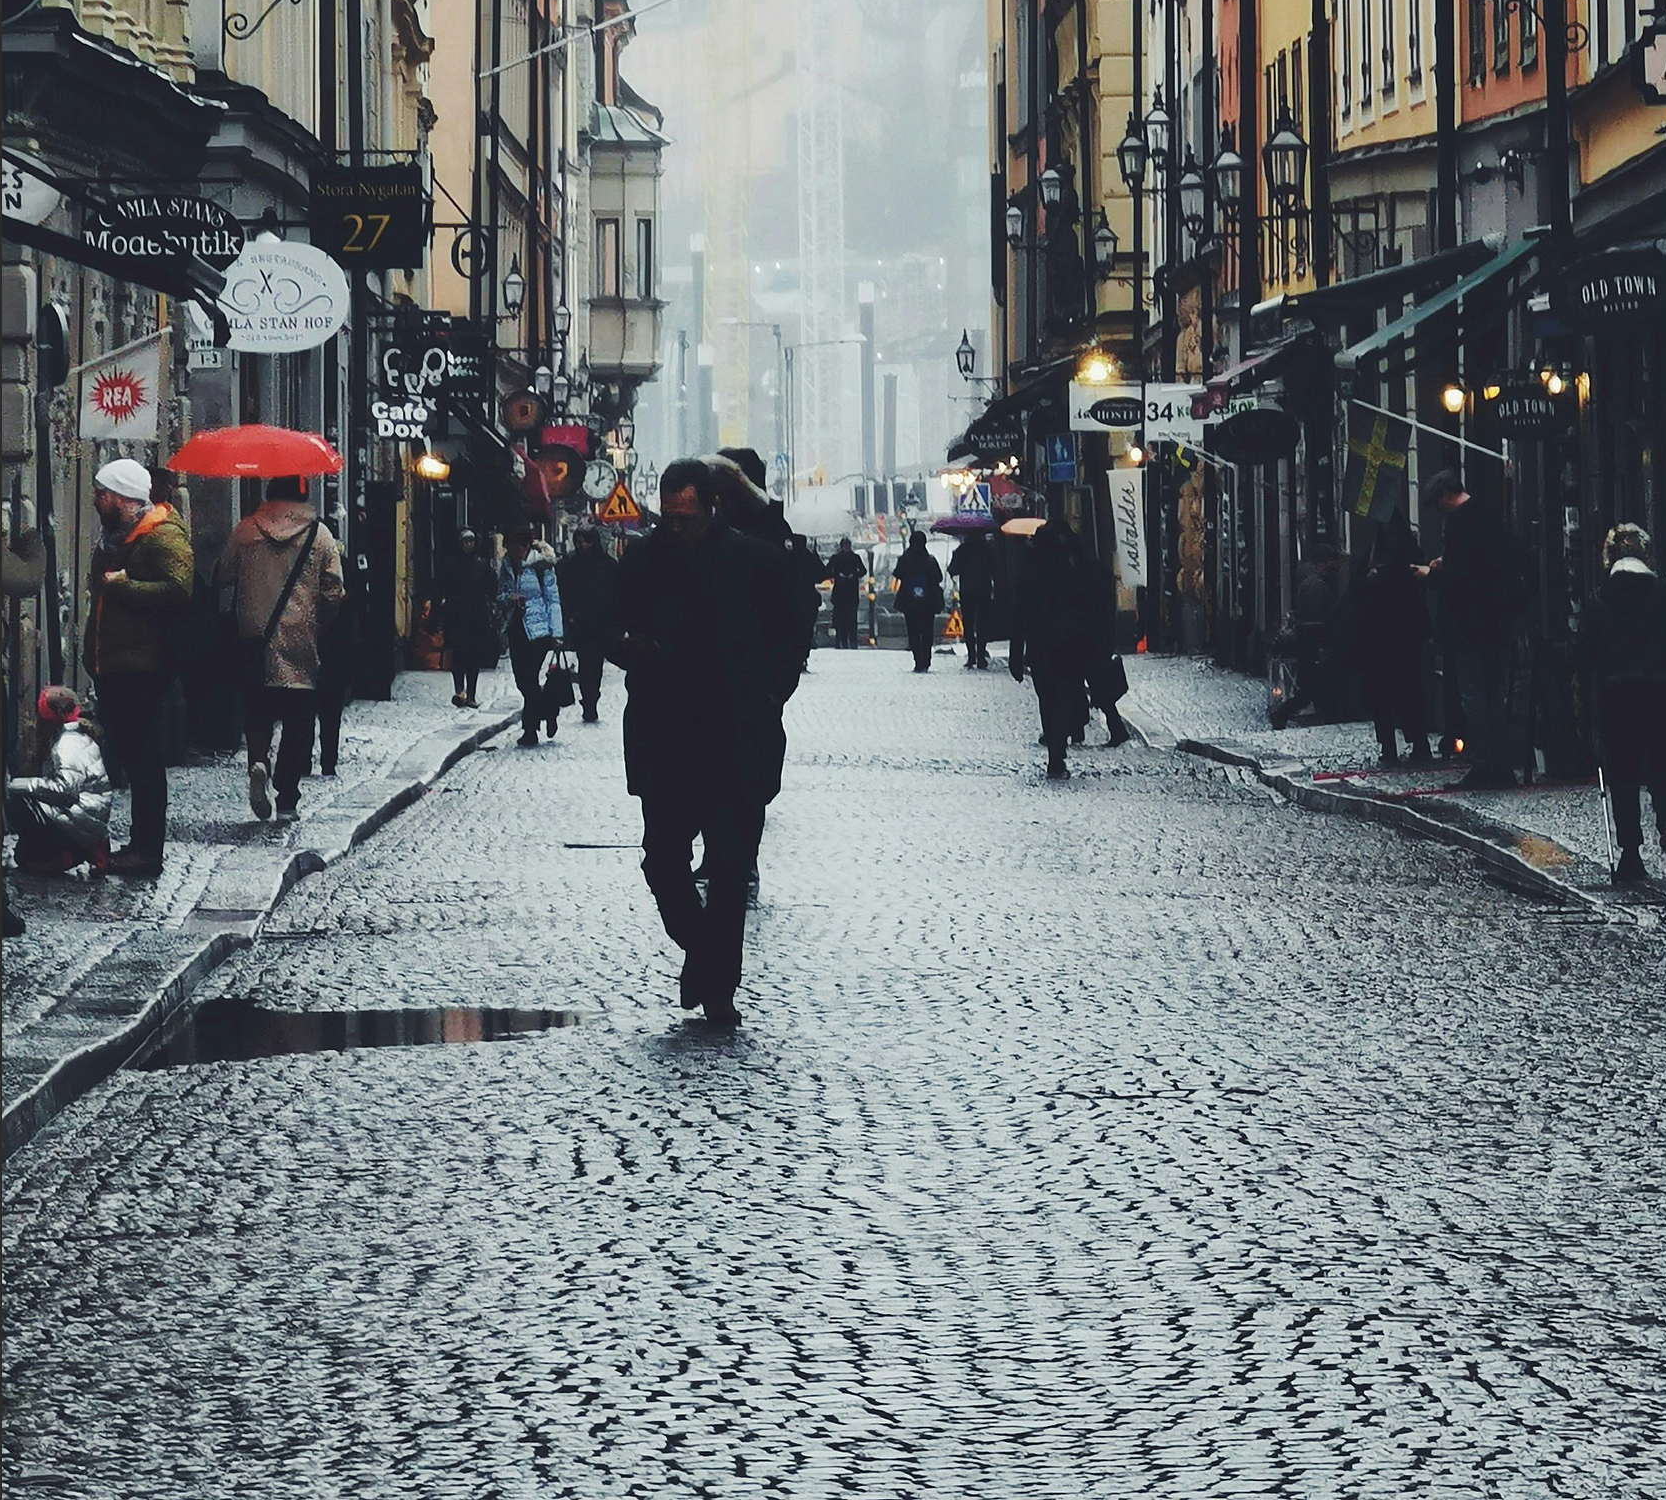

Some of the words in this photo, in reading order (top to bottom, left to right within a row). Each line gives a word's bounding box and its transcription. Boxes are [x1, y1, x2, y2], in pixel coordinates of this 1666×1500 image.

[317, 184, 354, 197] Stora
[359, 182, 416, 200] Nygatan
[166, 197, 226, 228] STANS
[342, 214, 391, 251] 27
[1581, 279, 1608, 304] OLD
[1614, 275, 1656, 296] TOWN
[260, 317, 298, 330] STAN
[102, 386, 132, 408] REA
[1147, 402, 1174, 423] 34
[1498, 400, 1520, 418] OLD
[378, 419, 425, 438] Dox
